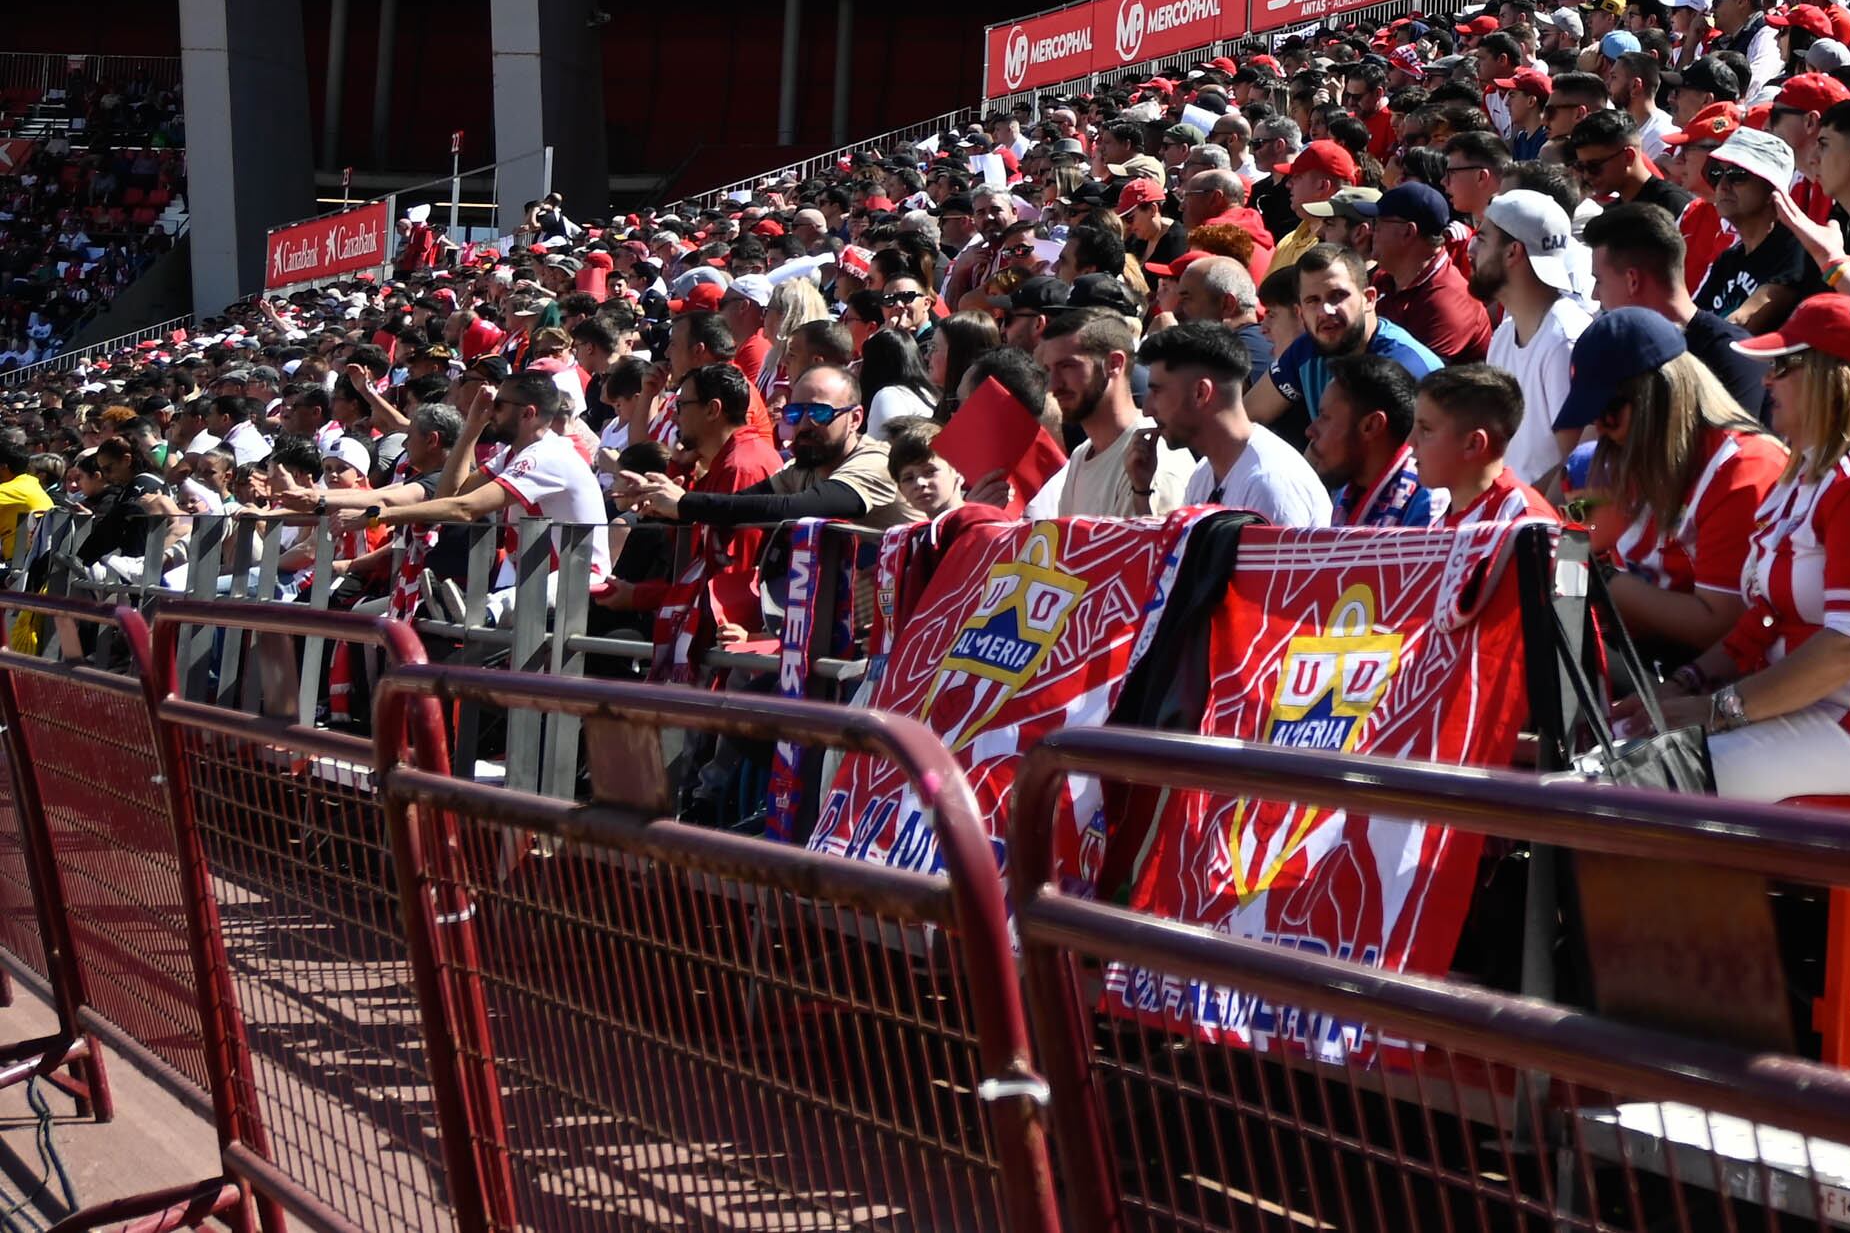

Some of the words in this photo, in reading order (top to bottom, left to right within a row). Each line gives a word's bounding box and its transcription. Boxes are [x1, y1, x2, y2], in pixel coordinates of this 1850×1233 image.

[1301, 0, 1326, 16] ANTAS
[1030, 27, 1093, 64] MERCOPHAL
[283, 236, 319, 273] CaixaBank
[337, 219, 378, 261] CaixaBank
[952, 630, 1033, 669] ALMERIA
[1272, 718, 1346, 751] ALMERIA
